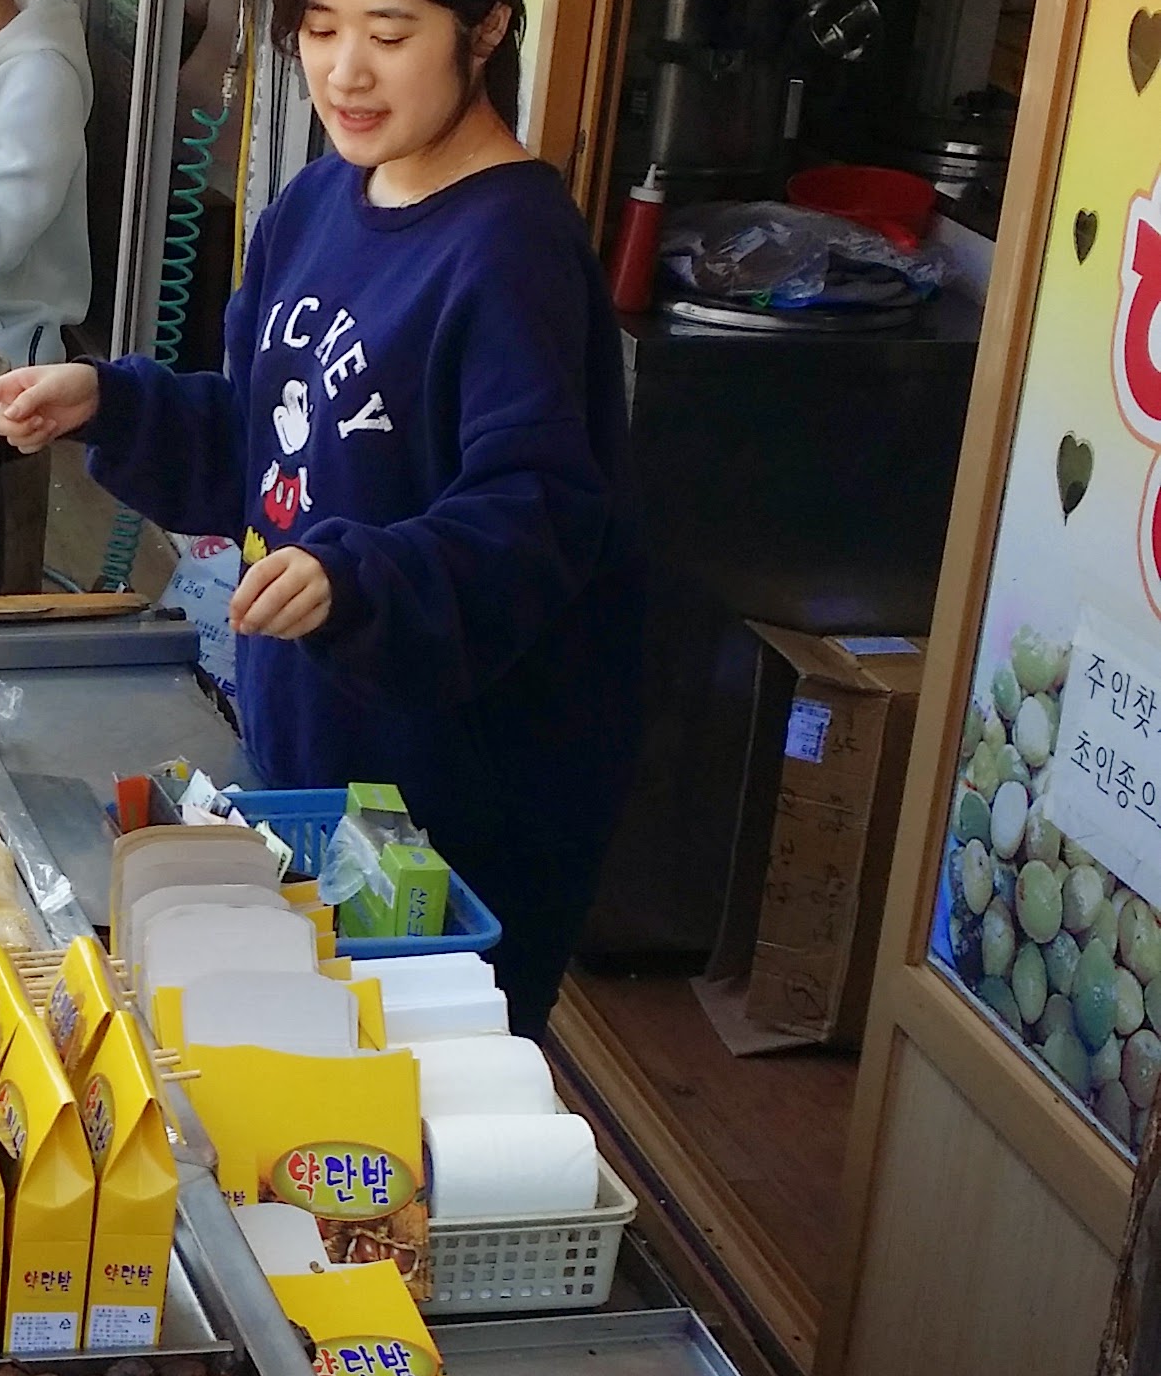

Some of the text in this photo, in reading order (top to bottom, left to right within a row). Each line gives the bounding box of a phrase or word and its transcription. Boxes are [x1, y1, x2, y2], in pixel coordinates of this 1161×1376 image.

[260, 296, 393, 439] ICKEY
[1085, 653, 1161, 739] 주인찾
[1070, 730, 1161, 830] 초인종으
[287, 1151, 393, 1204] 약단밤
[24, 1270, 72, 1292] 약단밤
[104, 1264, 153, 1286] 약단밤
